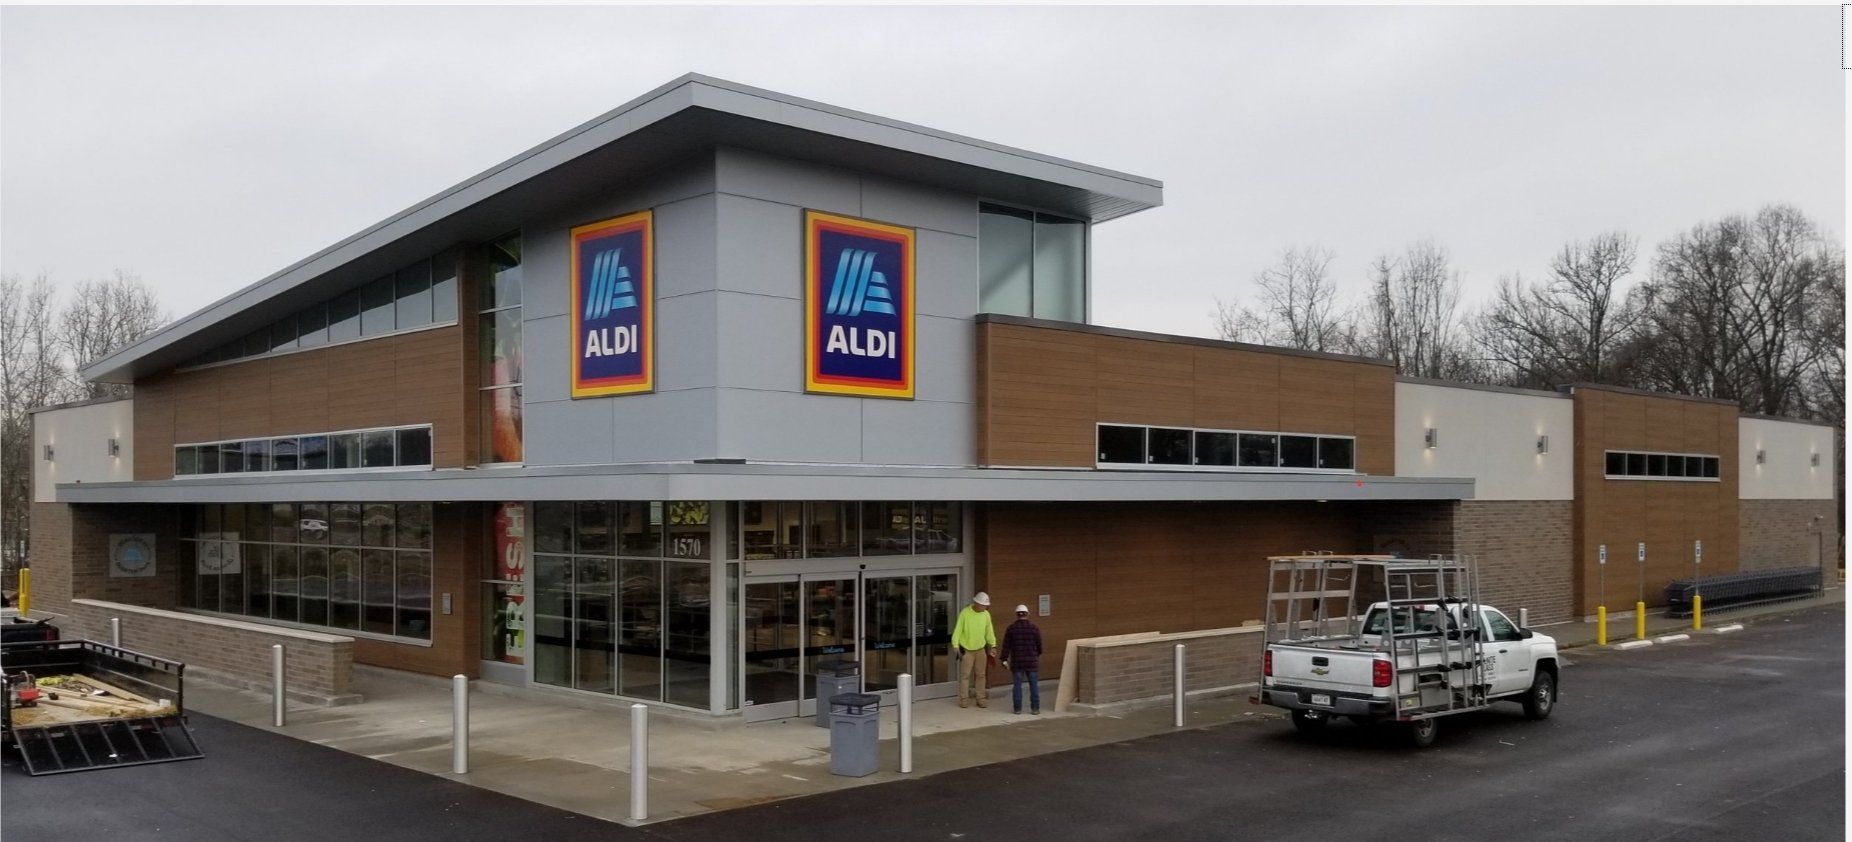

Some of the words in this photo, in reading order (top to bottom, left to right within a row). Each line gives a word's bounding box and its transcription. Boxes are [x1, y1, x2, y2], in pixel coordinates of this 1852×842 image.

[585, 324, 637, 358] ALDI
[826, 325, 896, 359] ALDI
[673, 538, 701, 556] 1570
[505, 507, 525, 656] FRESH
